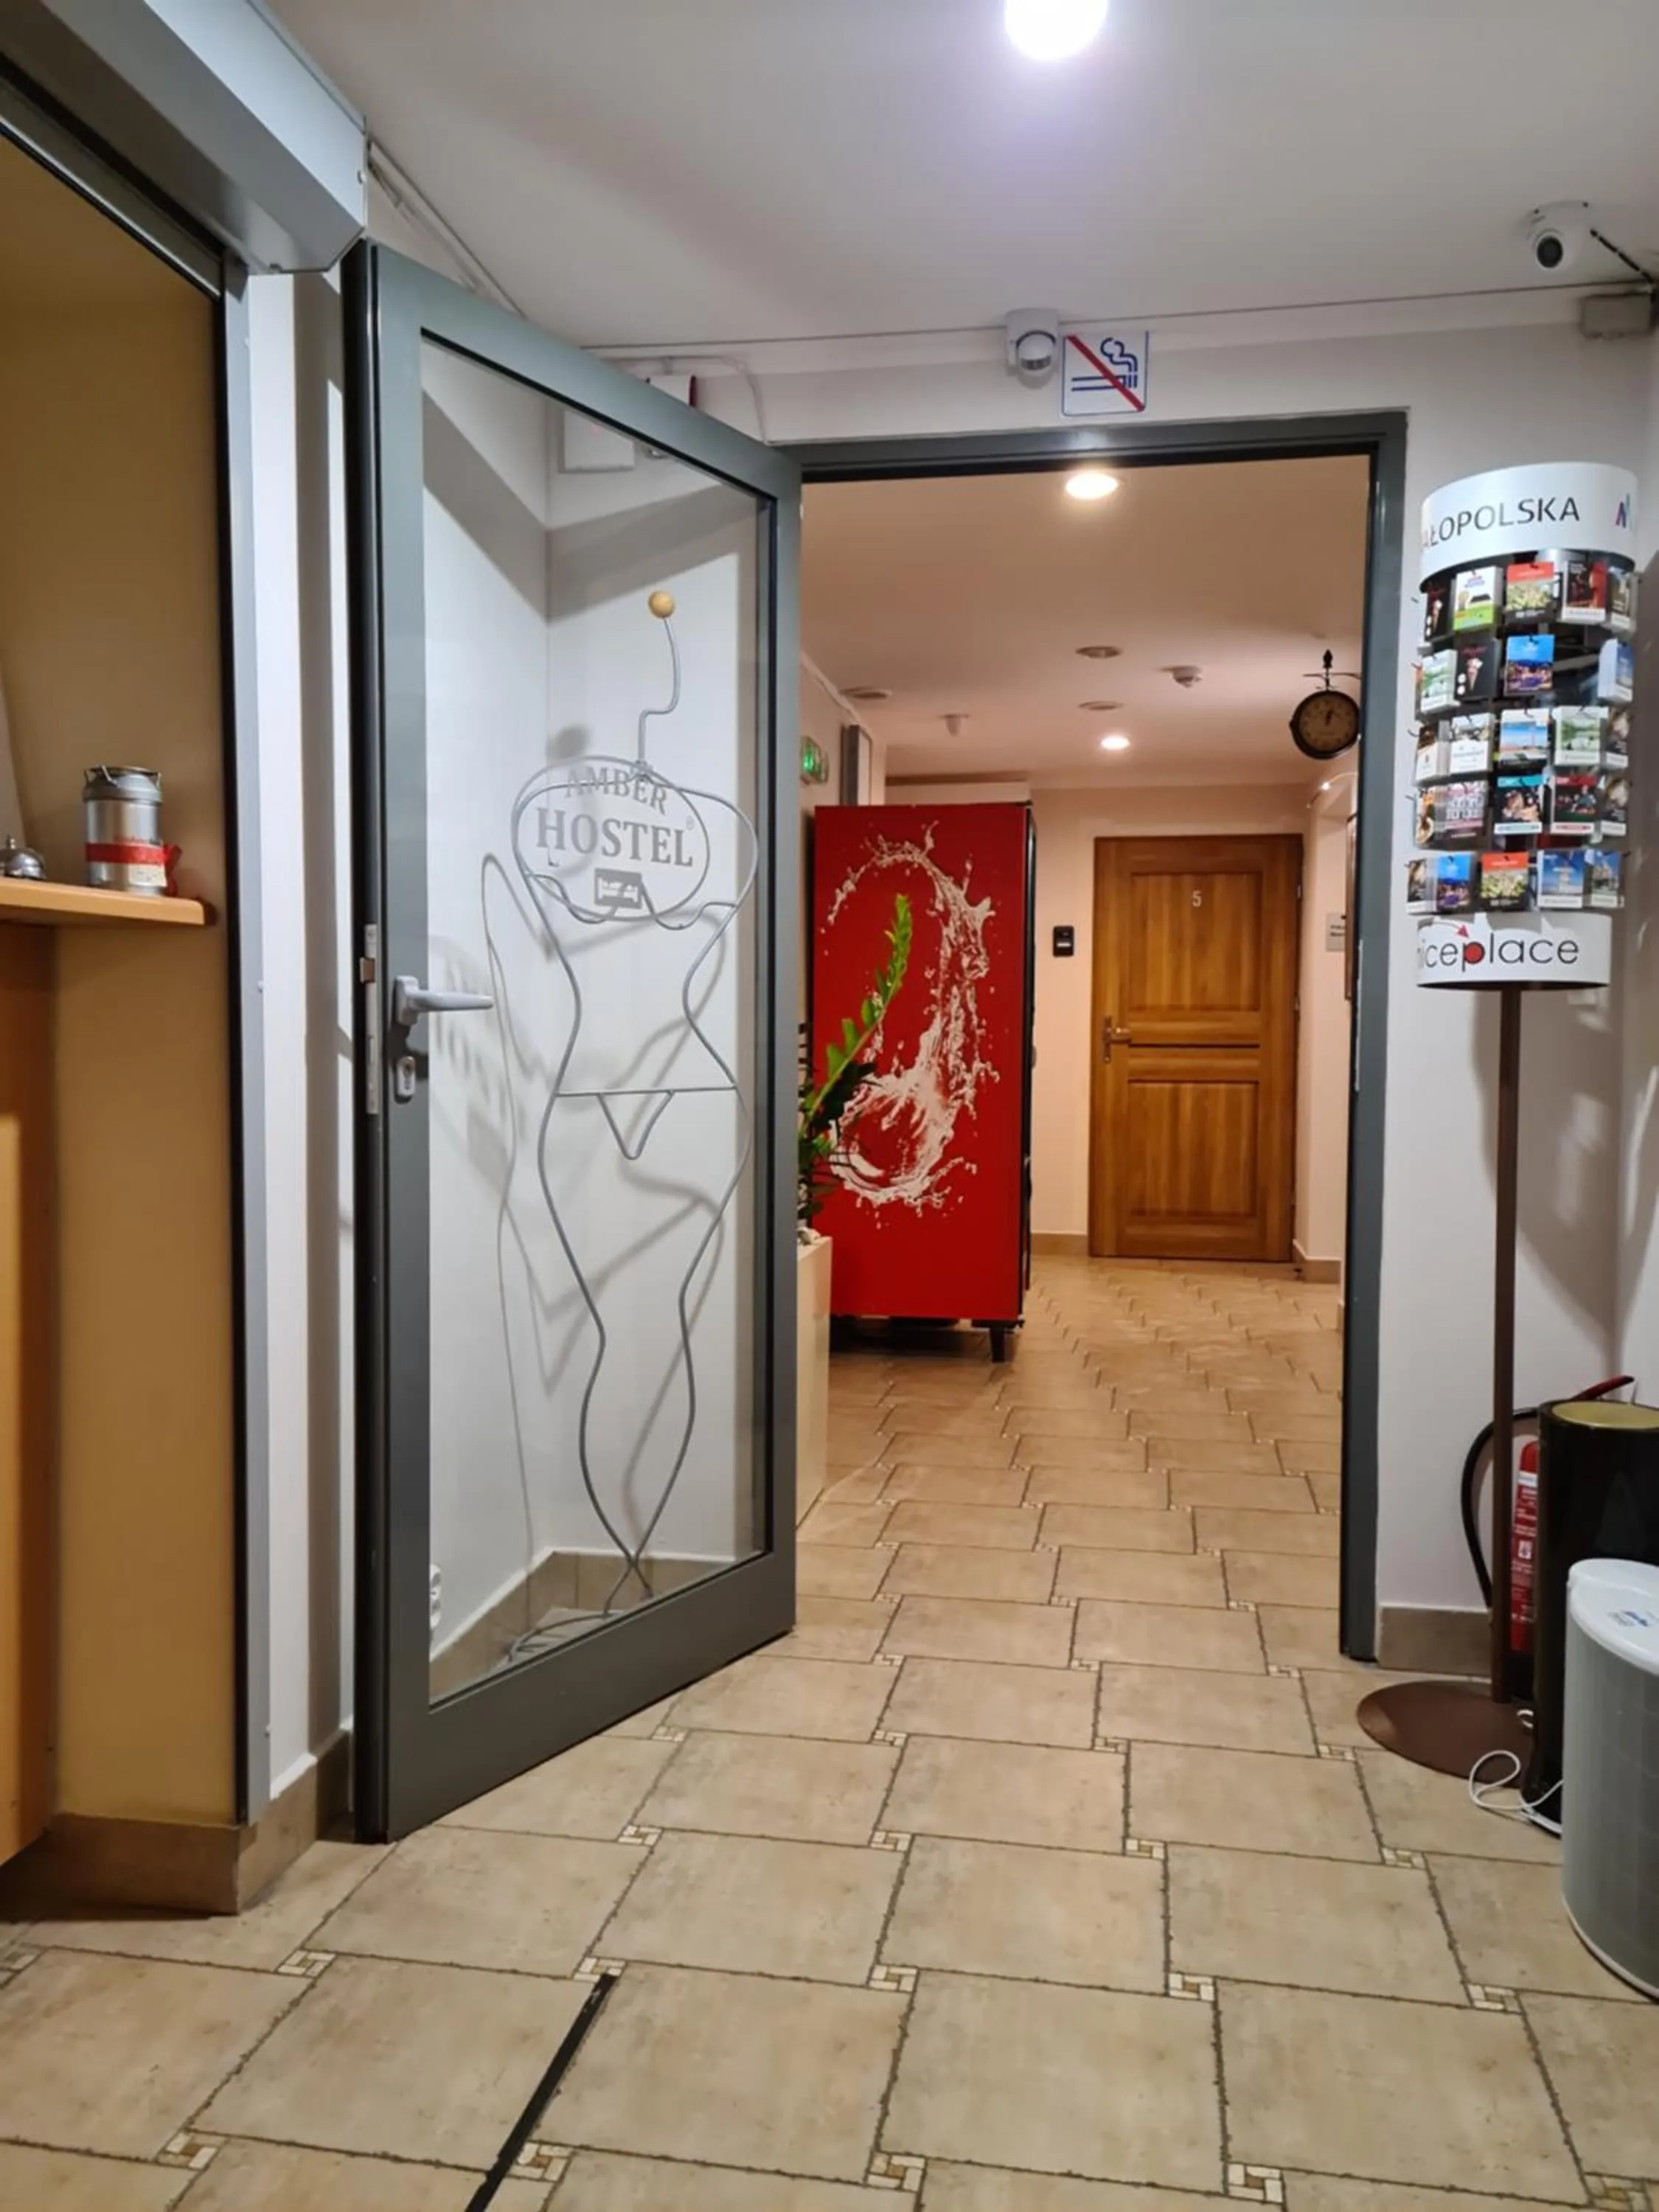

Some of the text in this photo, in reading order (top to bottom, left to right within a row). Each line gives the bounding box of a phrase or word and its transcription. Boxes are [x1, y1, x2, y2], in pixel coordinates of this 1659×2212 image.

[566, 766, 667, 815] AMBER
[535, 807, 693, 867] HOSTEL
[1192, 890, 1202, 907] 5
